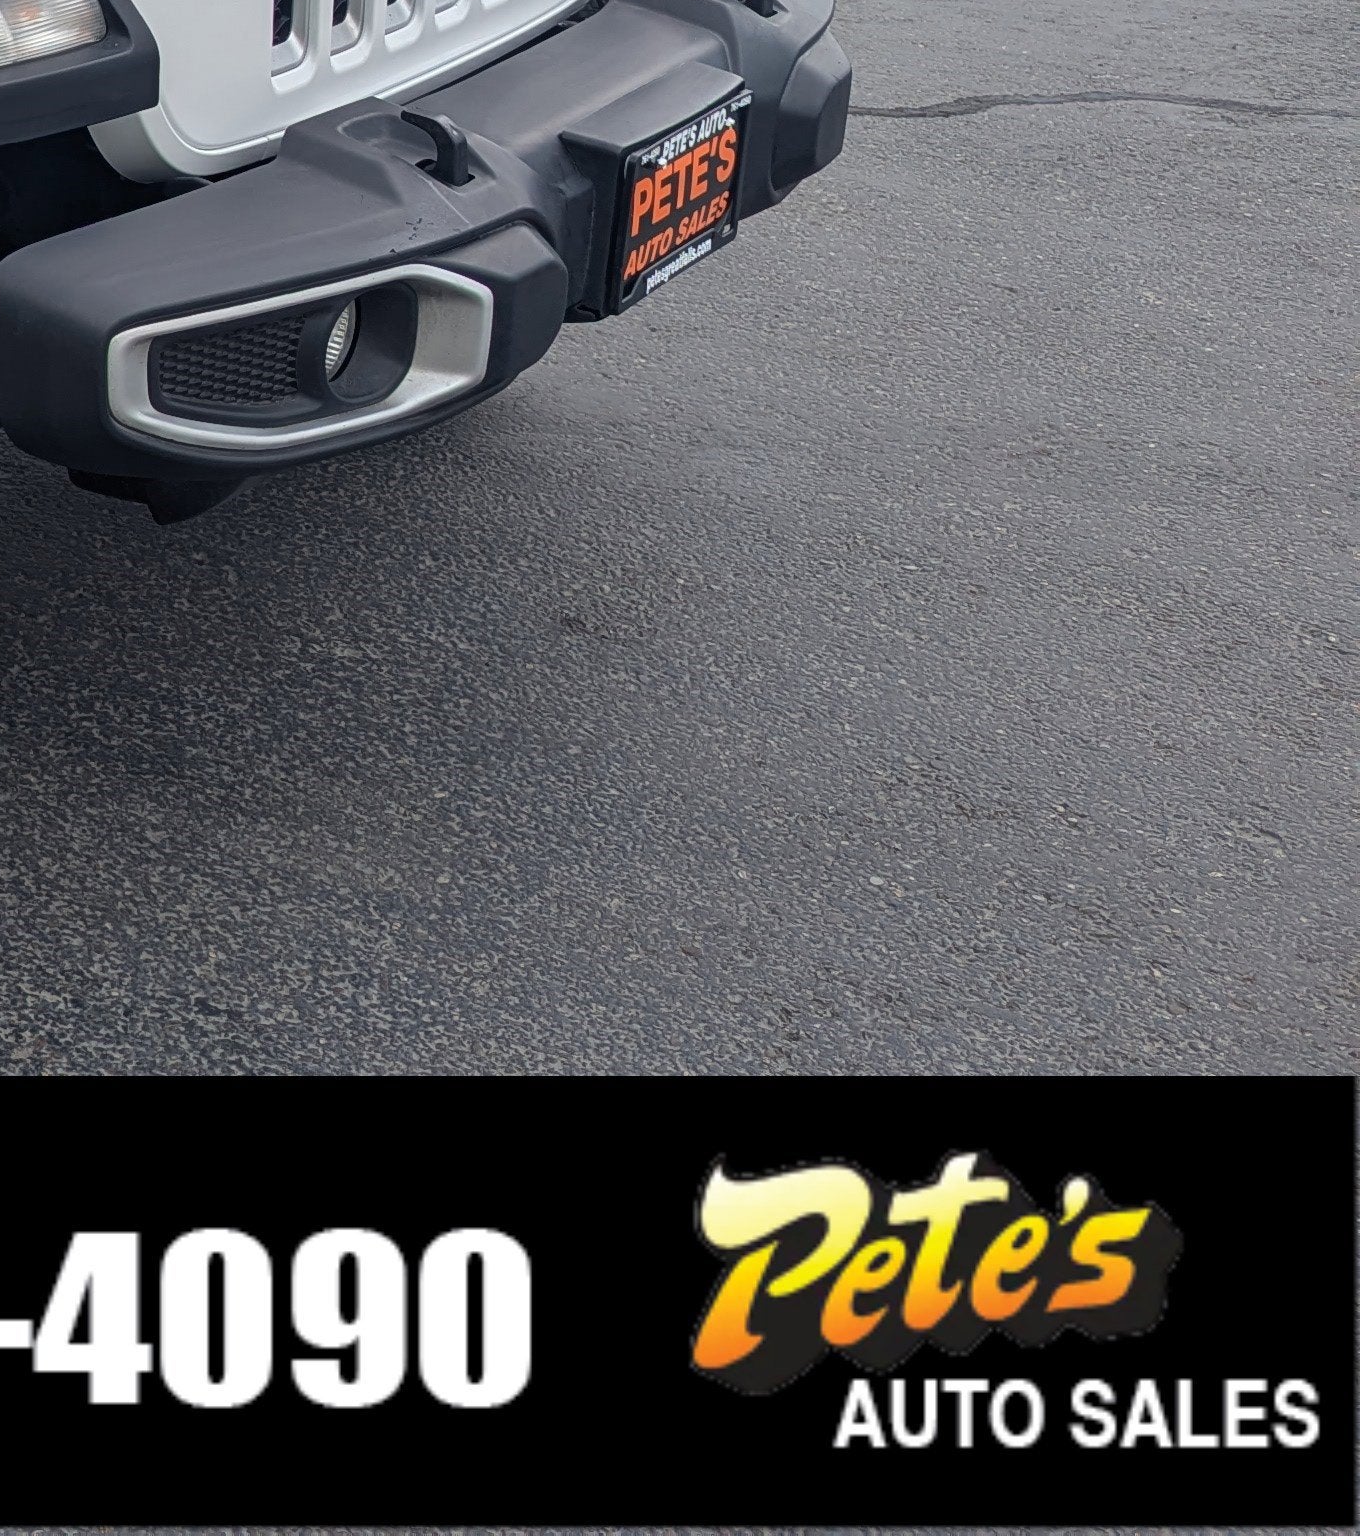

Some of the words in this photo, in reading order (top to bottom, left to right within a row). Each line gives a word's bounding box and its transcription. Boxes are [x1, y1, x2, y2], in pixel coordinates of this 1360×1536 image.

[663, 124, 697, 161] PETE'S
[697, 108, 727, 142] AUTO
[631, 127, 737, 237] PETE'S
[624, 227, 673, 281] AUTO
[675, 190, 730, 246] SALES
